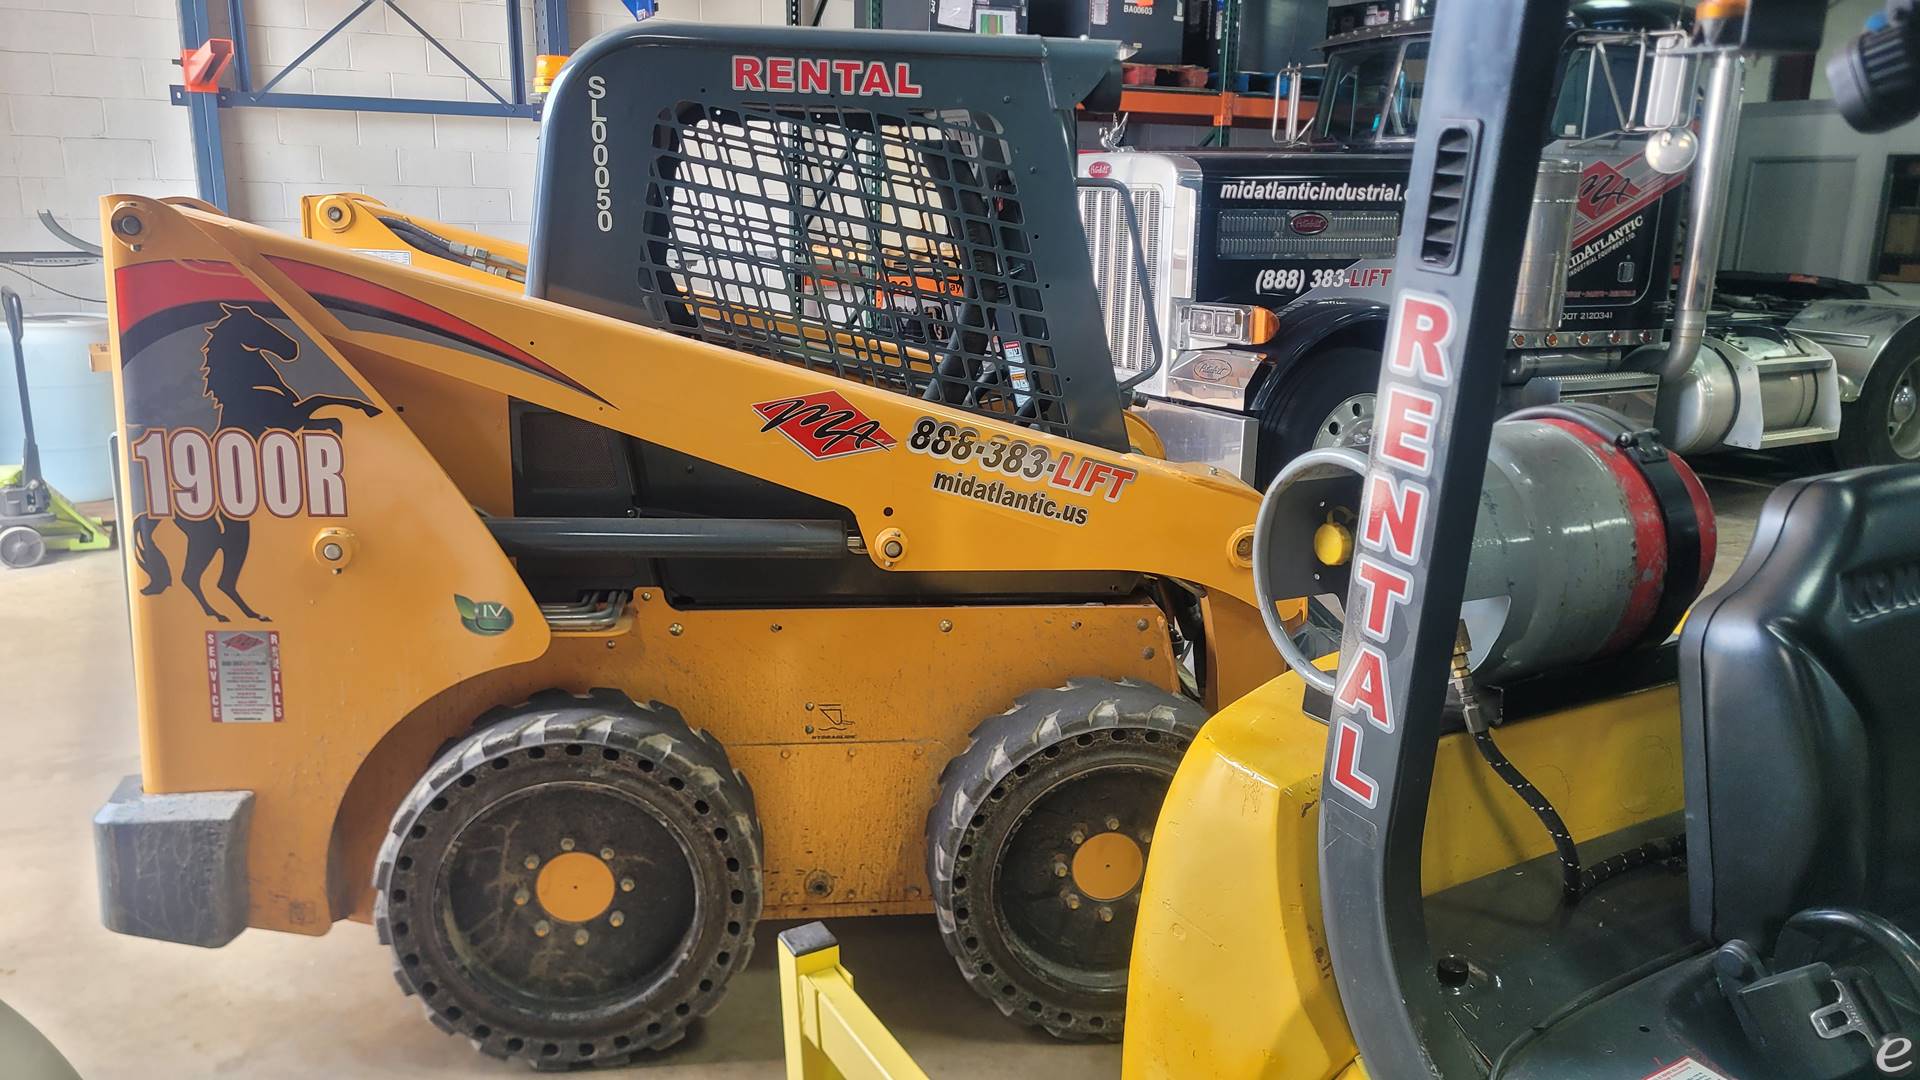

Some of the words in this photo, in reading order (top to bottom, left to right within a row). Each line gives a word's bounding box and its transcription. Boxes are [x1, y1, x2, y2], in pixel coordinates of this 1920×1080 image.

[733, 56, 921, 97] RENTAL
[588, 76, 612, 232] SL00050
[1255, 269, 1305, 295] (888)
[1309, 268, 1392, 288] 383-LIFT
[1580, 312, 1613, 320] 2120341
[133, 428, 348, 519] 1900R
[909, 418, 1136, 500] 888-383-LIFT
[933, 472, 1088, 525] midatlantic.us
[1331, 293, 1455, 809] RENTAL
[207, 633, 220, 718] SERVICE
